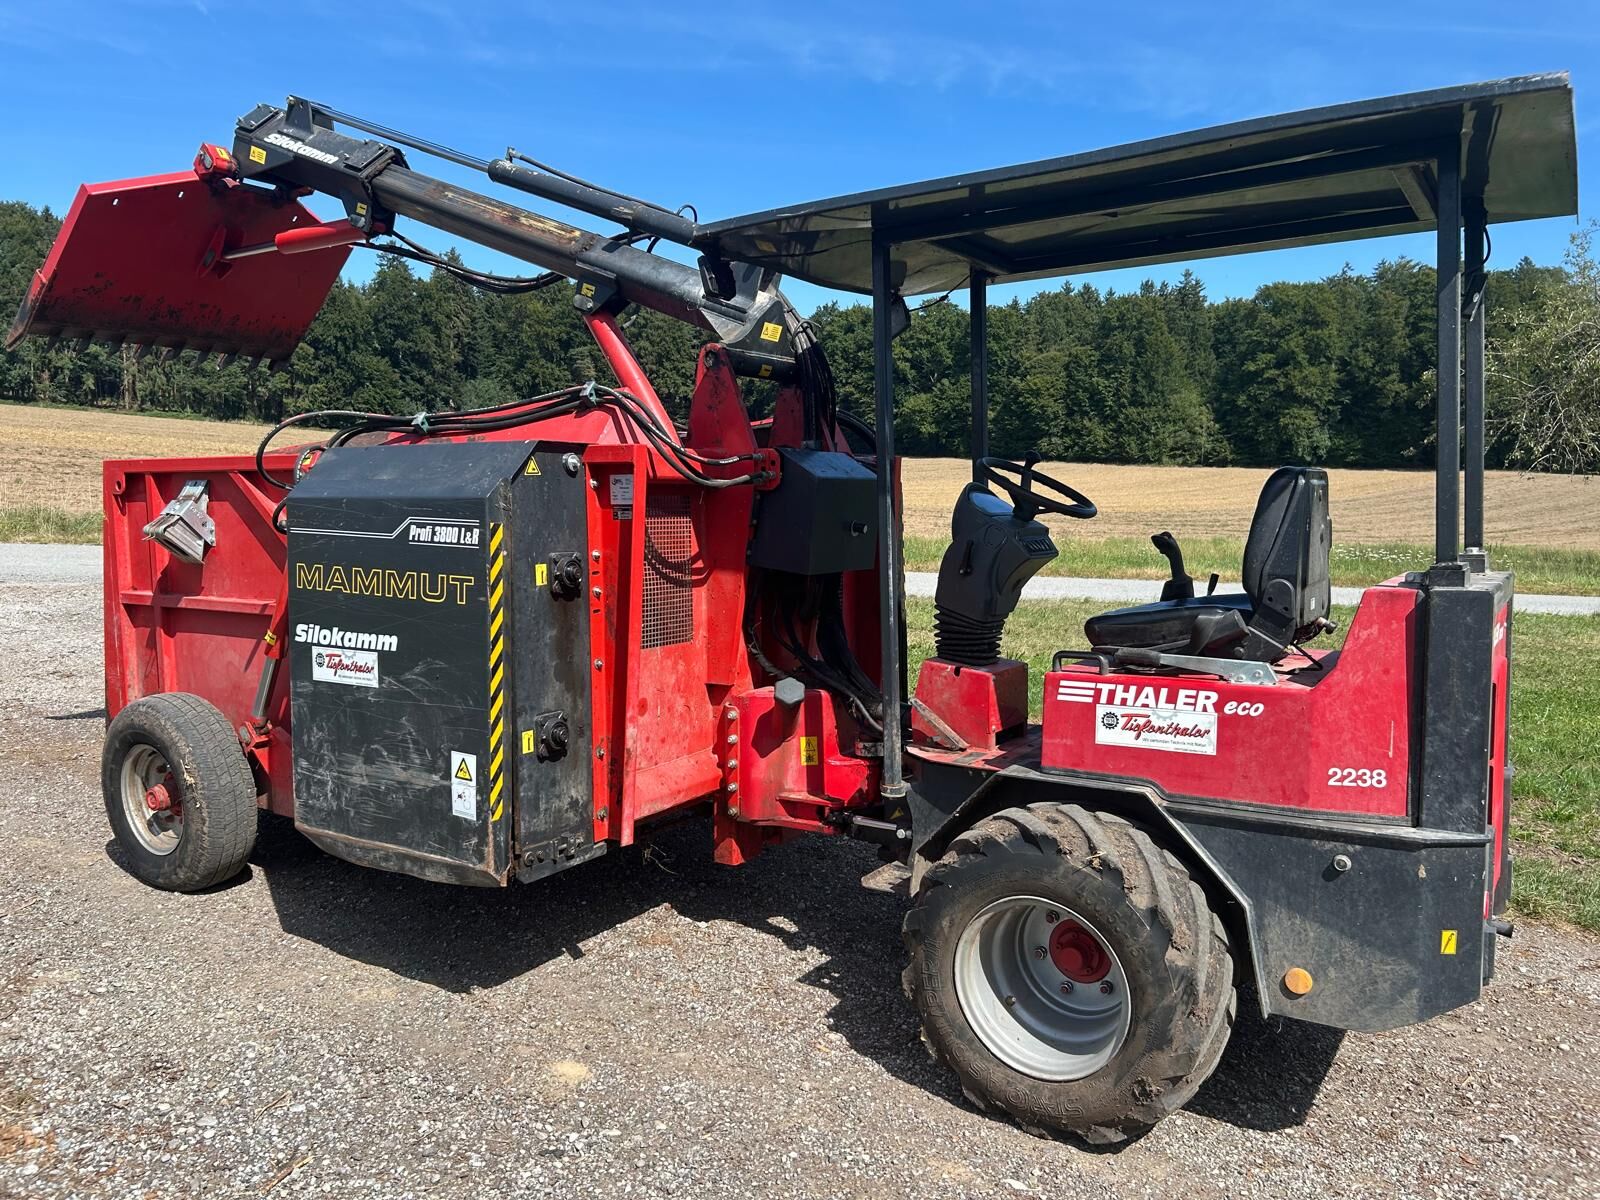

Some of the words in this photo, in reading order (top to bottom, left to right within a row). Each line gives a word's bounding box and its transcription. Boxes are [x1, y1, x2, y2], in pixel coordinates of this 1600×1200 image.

[264, 133, 339, 164] Silokamm
[409, 525, 433, 541] Profi
[434, 526, 459, 543] 3800
[460, 528, 480, 544] L&R
[296, 563, 475, 605] MAMMUT
[294, 623, 399, 652] Silokamm
[1095, 682, 1219, 713] THALER
[1223, 700, 1265, 717] eco
[1120, 713, 1211, 741] Tiefenthaler
[1327, 767, 1387, 788] 2238
